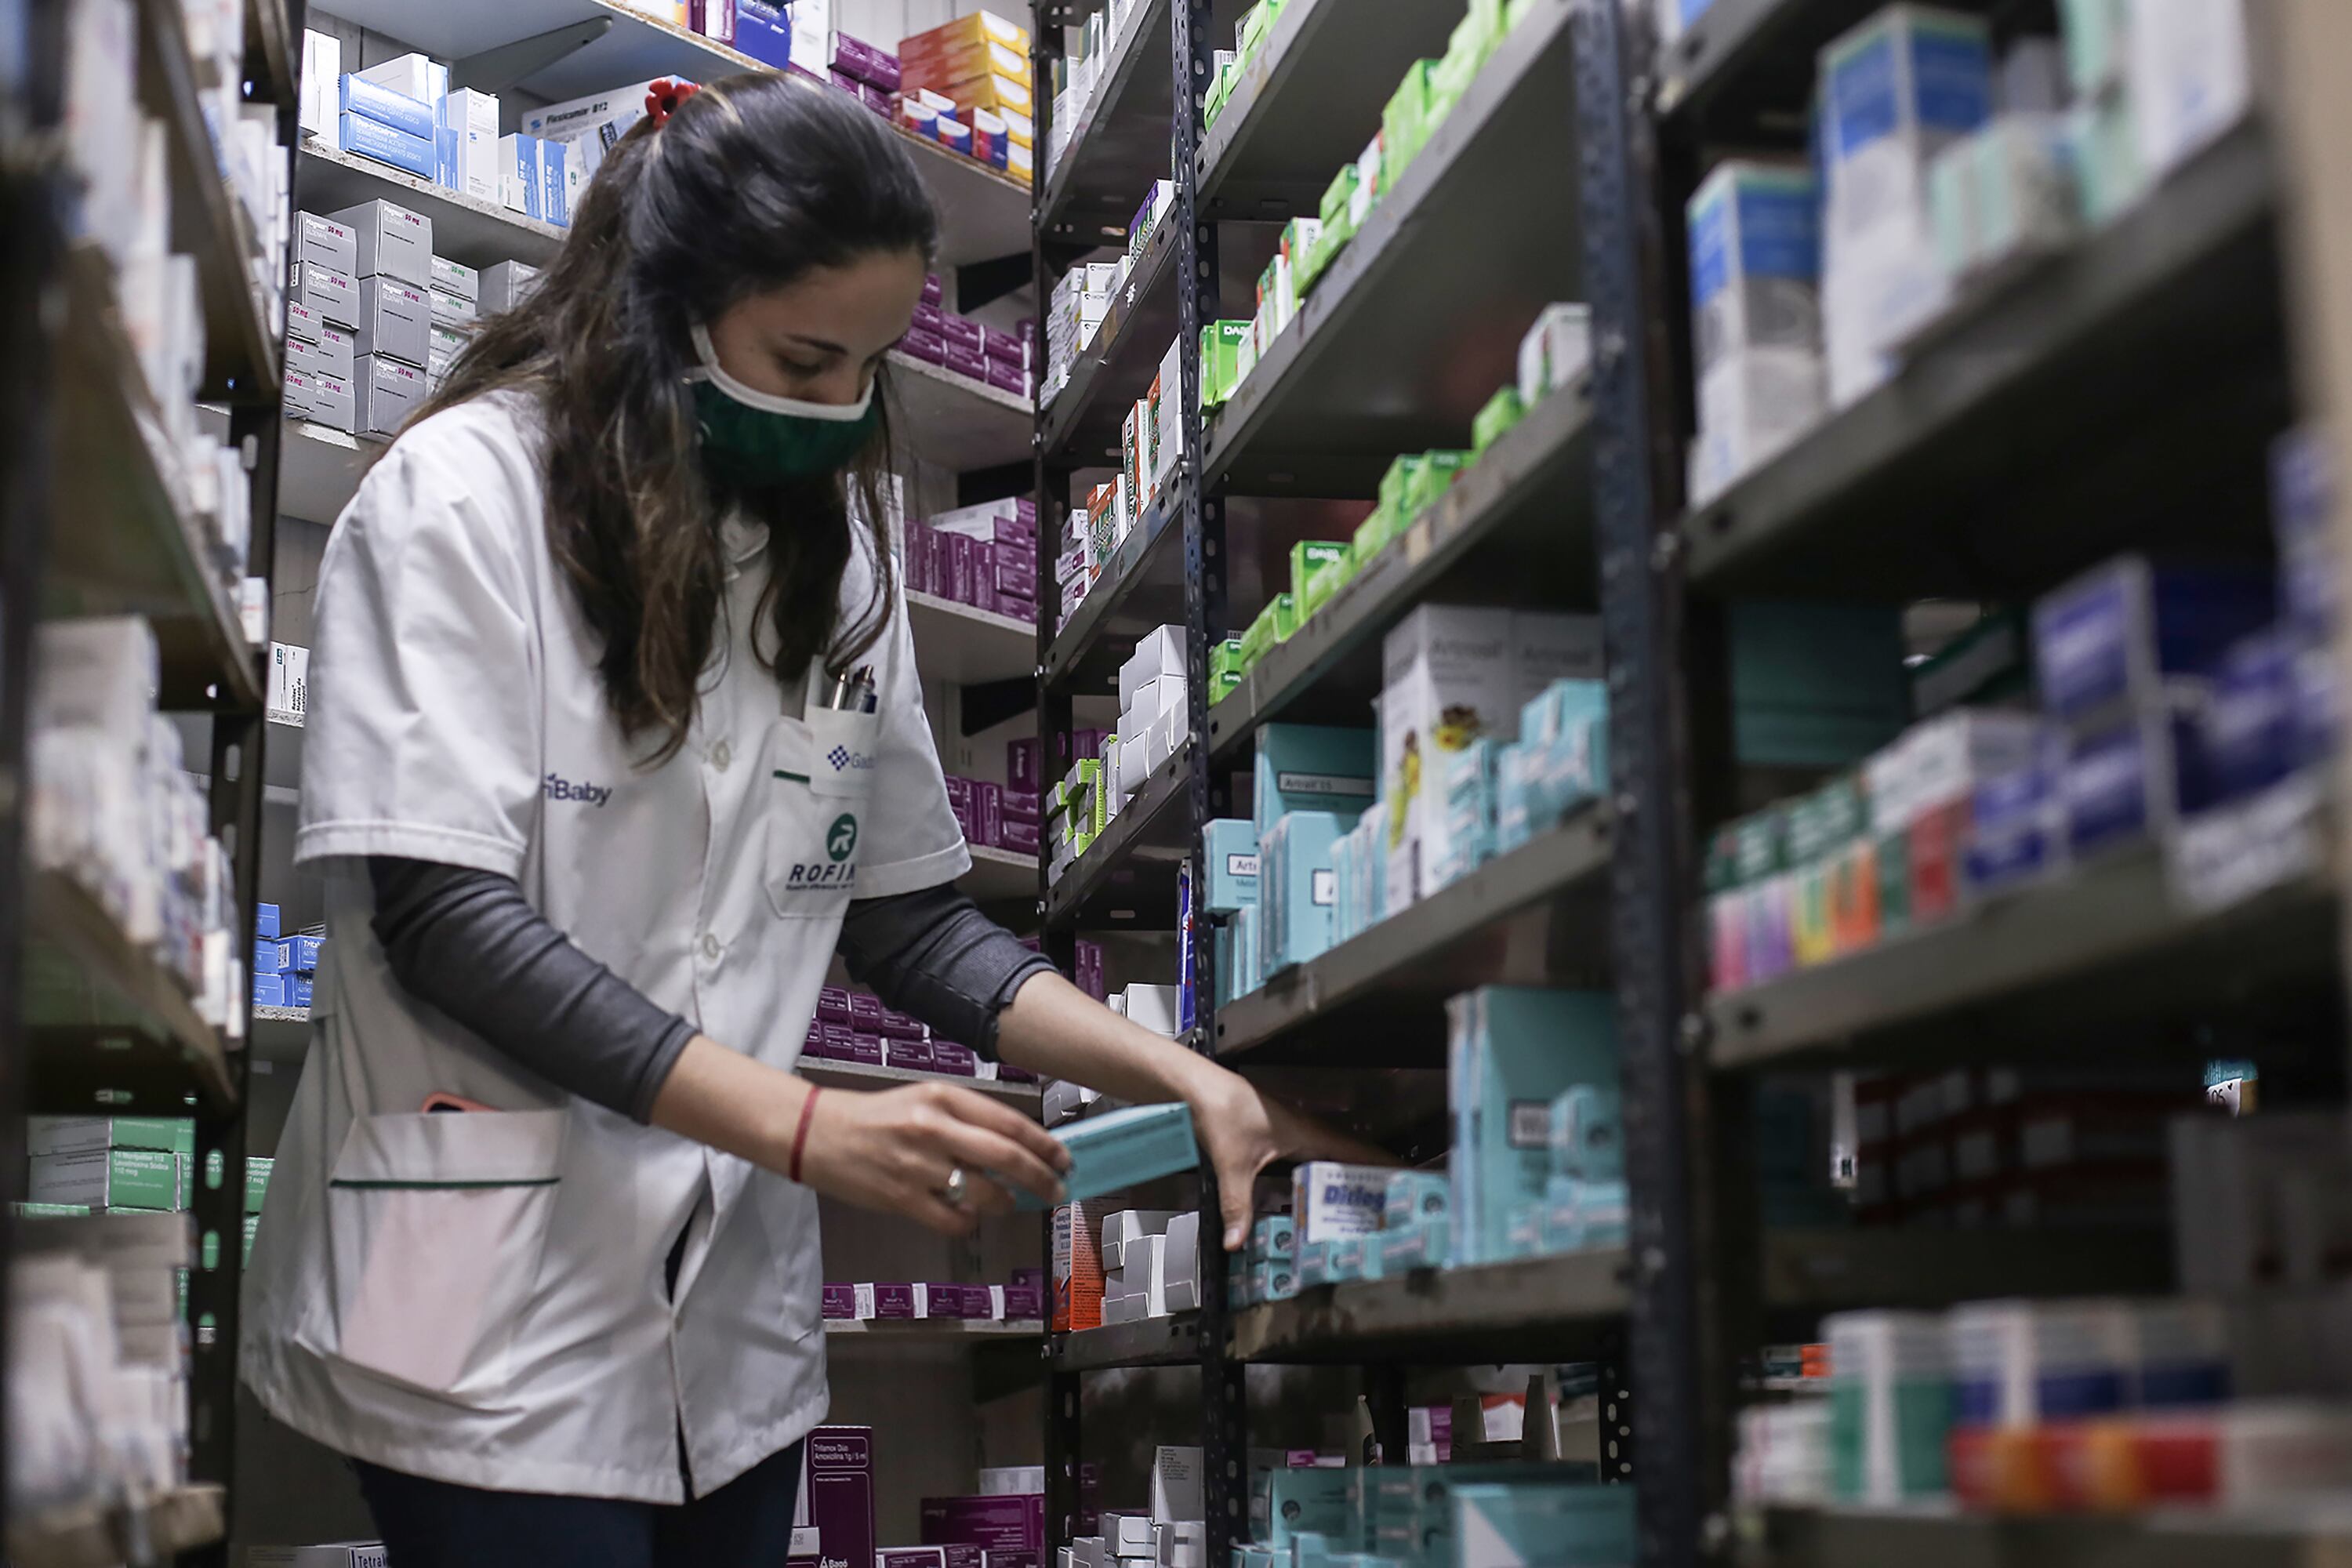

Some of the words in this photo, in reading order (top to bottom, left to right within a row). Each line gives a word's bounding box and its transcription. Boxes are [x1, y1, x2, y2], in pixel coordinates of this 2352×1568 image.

[412, 217, 420, 226] mg
[335, 229, 343, 238] mg
[338, 280, 346, 289] mg
[412, 294, 419, 303] mg
[300, 310, 308, 318] mg
[332, 334, 339, 343] mg
[296, 343, 304, 352] mg
[294, 378, 303, 387] mg
[332, 385, 340, 394] mg
